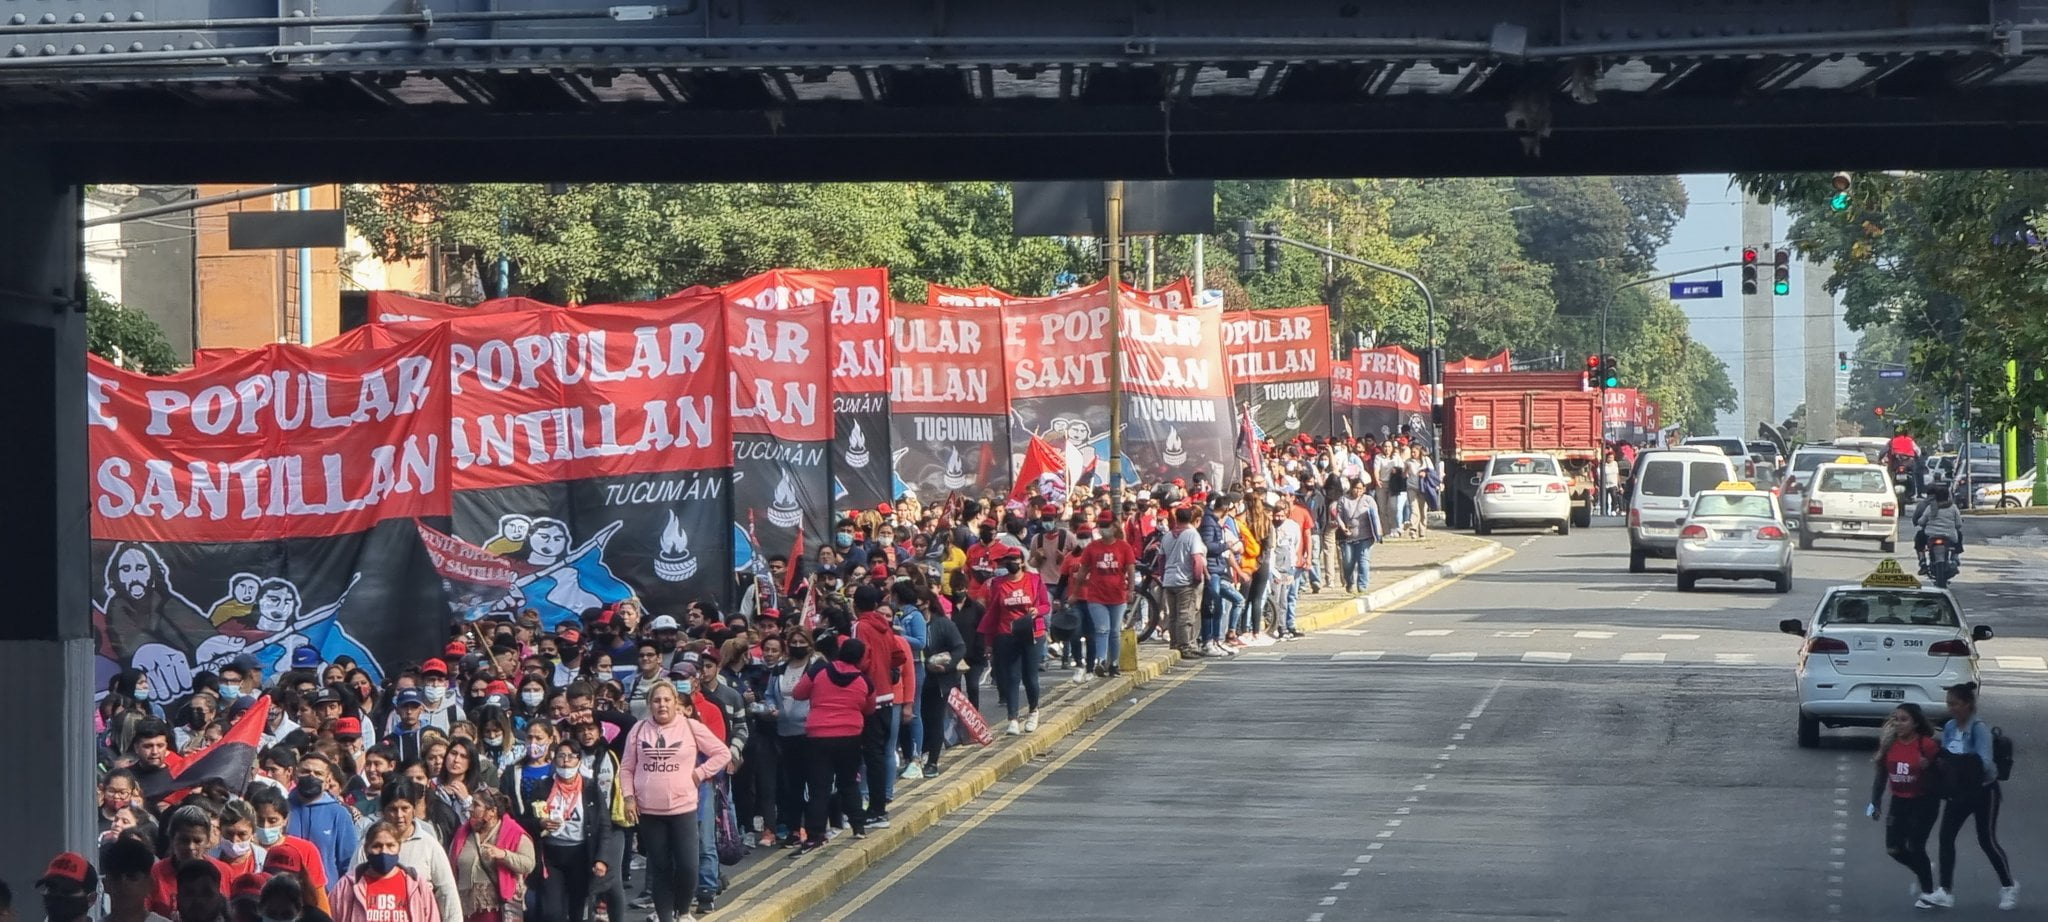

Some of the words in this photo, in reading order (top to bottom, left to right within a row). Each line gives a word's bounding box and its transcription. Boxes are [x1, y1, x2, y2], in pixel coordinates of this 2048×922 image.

[889, 316, 982, 355] ULAR
[145, 355, 433, 436] POPULAR
[1264, 381, 1319, 401] TUCUMAN
[1357, 379, 1413, 405] DARIO
[1133, 396, 1216, 422] TUCUMAN
[914, 417, 993, 442] TUCUMAN
[97, 434, 439, 520] SANTILLAN
[605, 472, 723, 506] TUCUMÁN
[643, 762, 680, 773] adidas
